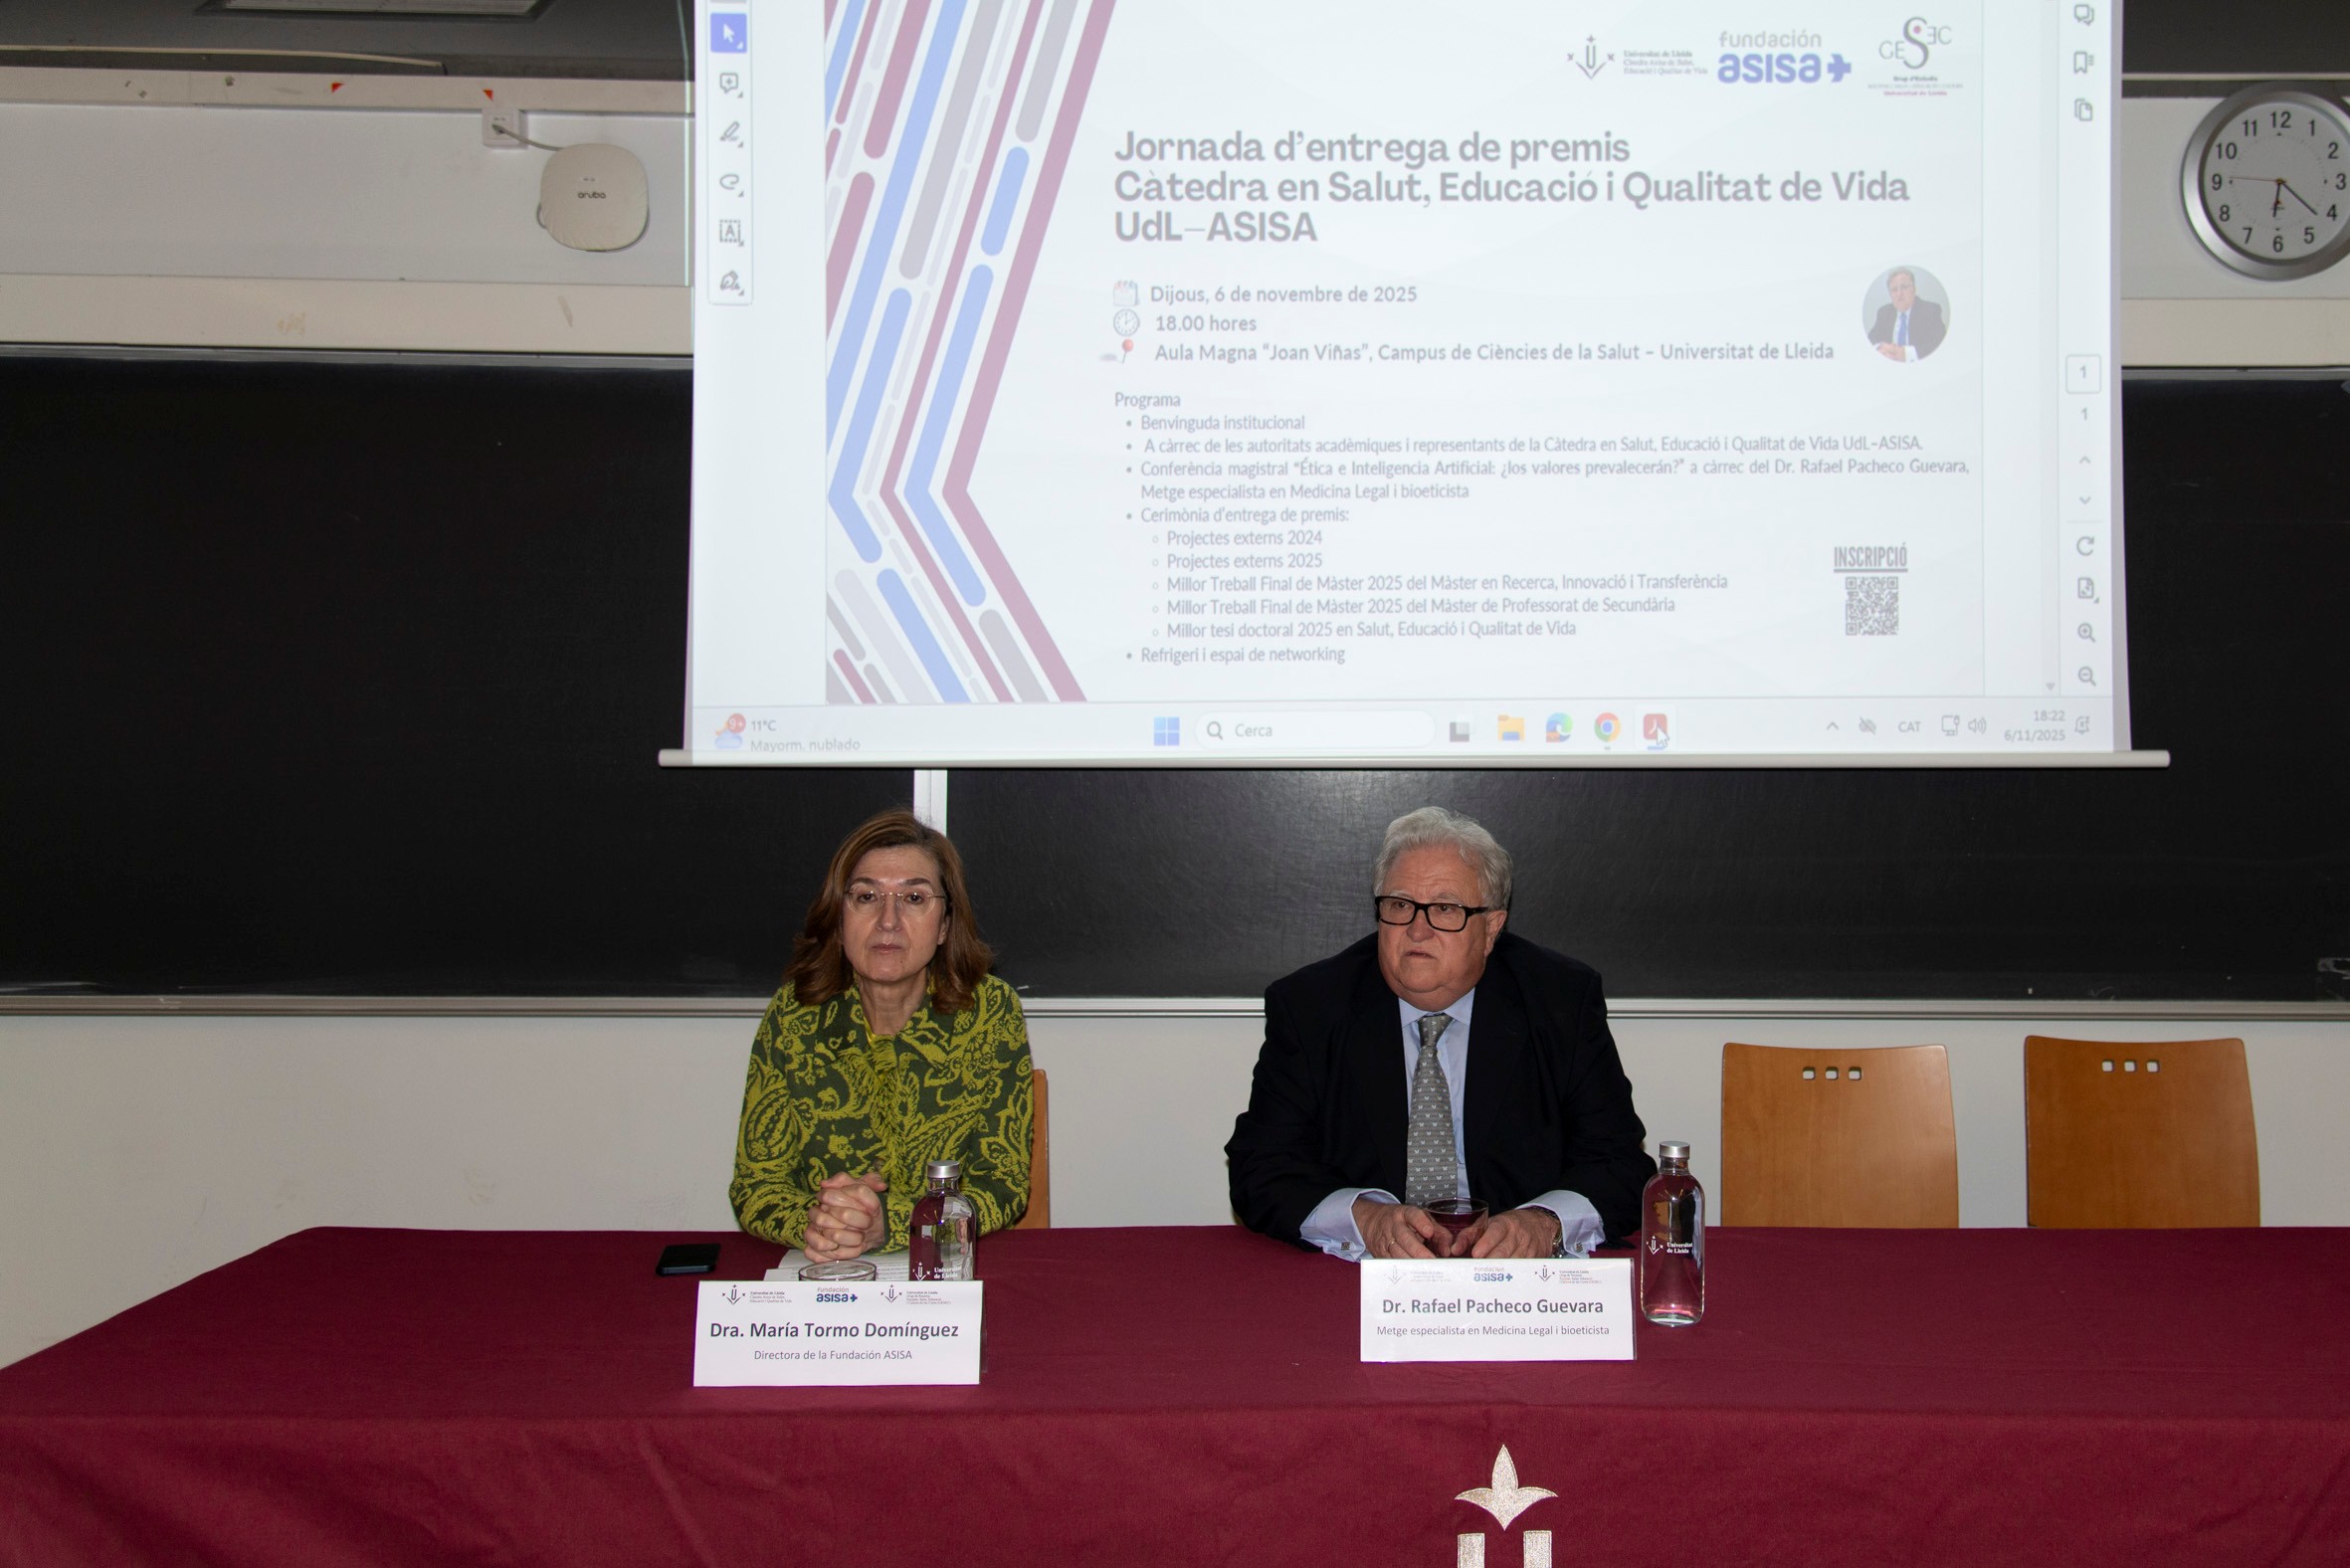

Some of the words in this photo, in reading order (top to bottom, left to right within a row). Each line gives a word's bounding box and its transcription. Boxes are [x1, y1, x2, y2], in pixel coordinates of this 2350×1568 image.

[1717, 28, 1823, 49] fundación
[1717, 52, 1822, 85] asisa
[2242, 119, 2257, 136] 11
[2269, 110, 2291, 128] 12
[2308, 118, 2316, 136] 1
[1114, 129, 1267, 161] Jornada
[1459, 130, 1501, 161] de
[1510, 129, 1631, 168] premis
[2216, 141, 2238, 159] 10
[2327, 141, 2339, 159] 2
[1114, 169, 1270, 202] Càtedra
[1276, 178, 1320, 202] en
[1327, 170, 1432, 209] Salut,
[1440, 169, 1599, 202] Educació
[1606, 169, 1615, 202] i
[1623, 169, 1773, 211] Qualitat
[1780, 169, 1823, 202] de
[1831, 169, 1911, 202] Vida
[2211, 173, 2223, 191] 9
[2335, 172, 2347, 190] 3
[577, 190, 607, 200] aruba
[2219, 204, 2231, 222] 8
[2326, 203, 2337, 221] 4
[2243, 227, 2252, 245] 7
[2272, 235, 2283, 253] 6
[2303, 227, 2314, 245] 5
[1150, 284, 1210, 306] Dijous,
[1214, 286, 1227, 302] 6
[1230, 284, 1252, 302] de
[1257, 285, 1343, 302] novembre
[1347, 285, 1369, 302] de
[1373, 286, 1418, 302] 2025
[1155, 314, 1206, 332] 18.00
[1209, 313, 1258, 332] hores
[1154, 342, 1195, 361] Aula
[1199, 343, 1258, 365] Magna
[1377, 343, 1447, 365] Campus
[1451, 342, 1472, 361] de
[1476, 342, 1548, 361] Ciències
[1551, 342, 1574, 360] de
[1578, 342, 1593, 361] la
[1597, 342, 1641, 360] Salut
[1660, 342, 1755, 360] Universitat
[1758, 341, 1780, 360] de
[1785, 341, 1835, 360] Lleida
[2079, 365, 2086, 378] 1
[1114, 391, 1182, 411] Programa
[1140, 413, 1221, 435] Benvinguda
[1224, 414, 1305, 431] institucional
[1140, 460, 1224, 477] Conferència
[1228, 461, 1289, 481] magistral
[1337, 463, 1347, 477] e
[1351, 460, 1431, 480] Inteligencia
[1434, 459, 1496, 476] Artificial:
[1500, 460, 1528, 480] ¿los
[1530, 460, 1582, 476] valores
[1689, 462, 1698, 475] a
[1702, 459, 1745, 475] càrrec
[1748, 459, 1770, 475] del
[1774, 458, 1796, 475] Dr.
[1800, 458, 1844, 475] Rafael
[1848, 457, 1905, 474] Pacheco
[1908, 457, 1970, 475] Guevara,
[1140, 484, 1186, 503] Metge
[1188, 484, 1267, 503] especialista
[1269, 487, 1286, 499] en
[1289, 483, 1352, 499] Medicina
[1354, 483, 1390, 502] Legal
[1393, 483, 1398, 498] i
[1400, 483, 1469, 499] bioeticista
[1140, 506, 1211, 523] Cerimònia
[1279, 506, 1298, 522] de
[1300, 505, 1350, 526] premis:
[1167, 529, 1231, 549] Projectes
[1233, 530, 1284, 546] externs
[1286, 528, 1324, 546] 2024
[1834, 541, 1908, 568] INSCRIPCIÓ
[1167, 576, 1208, 593] Millor
[1209, 574, 1258, 592] Treball
[1260, 575, 1293, 592] Final
[1295, 575, 1313, 592] de
[1316, 575, 1365, 592] Màster
[1367, 574, 1404, 591] 2025
[1406, 574, 1428, 591] del
[1431, 574, 1478, 591] Màster
[1480, 577, 1498, 591] en
[1501, 573, 1559, 592] Recerca,
[1562, 573, 1628, 590] Innovació
[1630, 573, 1635, 590] i
[1636, 572, 1728, 590] Transferència
[1167, 622, 1208, 639] Millor
[1210, 622, 1235, 638] tesi
[1238, 621, 1294, 638] doctoral
[1296, 620, 1333, 638] 2025
[1335, 624, 1354, 637] en
[1356, 620, 1395, 639] Salut,
[1397, 620, 1459, 637] Educació
[1461, 620, 1466, 637] i
[1468, 620, 1524, 639] Qualitat
[1525, 620, 1544, 636] de
[1545, 620, 1577, 636] Vida
[1140, 646, 1200, 667] Refrigeri
[1202, 647, 1207, 663] i
[1209, 646, 1245, 666] espai
[1248, 646, 1267, 663] de
[1269, 646, 1346, 666] networking
[2034, 708, 2066, 722] 18:22
[1234, 722, 1273, 738] Cerca
[1897, 720, 1922, 733] CAT
[2004, 728, 2066, 743] 6/11/2025
[750, 740, 805, 754] Mayorm.
[810, 738, 862, 751] nublado
[1473, 1273, 1504, 1282] asisa
[816, 1292, 849, 1303] asisa
[1382, 1298, 1406, 1313] Dr.
[1411, 1297, 1462, 1314] Rafael
[1466, 1297, 1532, 1313] Pacheco
[1536, 1298, 1604, 1313] Guevara
[709, 1322, 744, 1338] Dra.
[750, 1321, 799, 1338] María
[804, 1322, 860, 1338] Tormo
[865, 1321, 959, 1341] Domínguez
[1376, 1325, 1408, 1338] Metge
[1410, 1325, 1466, 1337] especialista
[1481, 1325, 1526, 1335] Medicina
[1528, 1324, 1553, 1337] Legal
[1555, 1325, 1559, 1335] i
[1560, 1325, 1610, 1335] bioeticista
[754, 1350, 801, 1360] Directora
[803, 1349, 817, 1360] de
[818, 1349, 828, 1360] la
[830, 1349, 881, 1360] Fundación
[882, 1349, 913, 1360] ASISA
